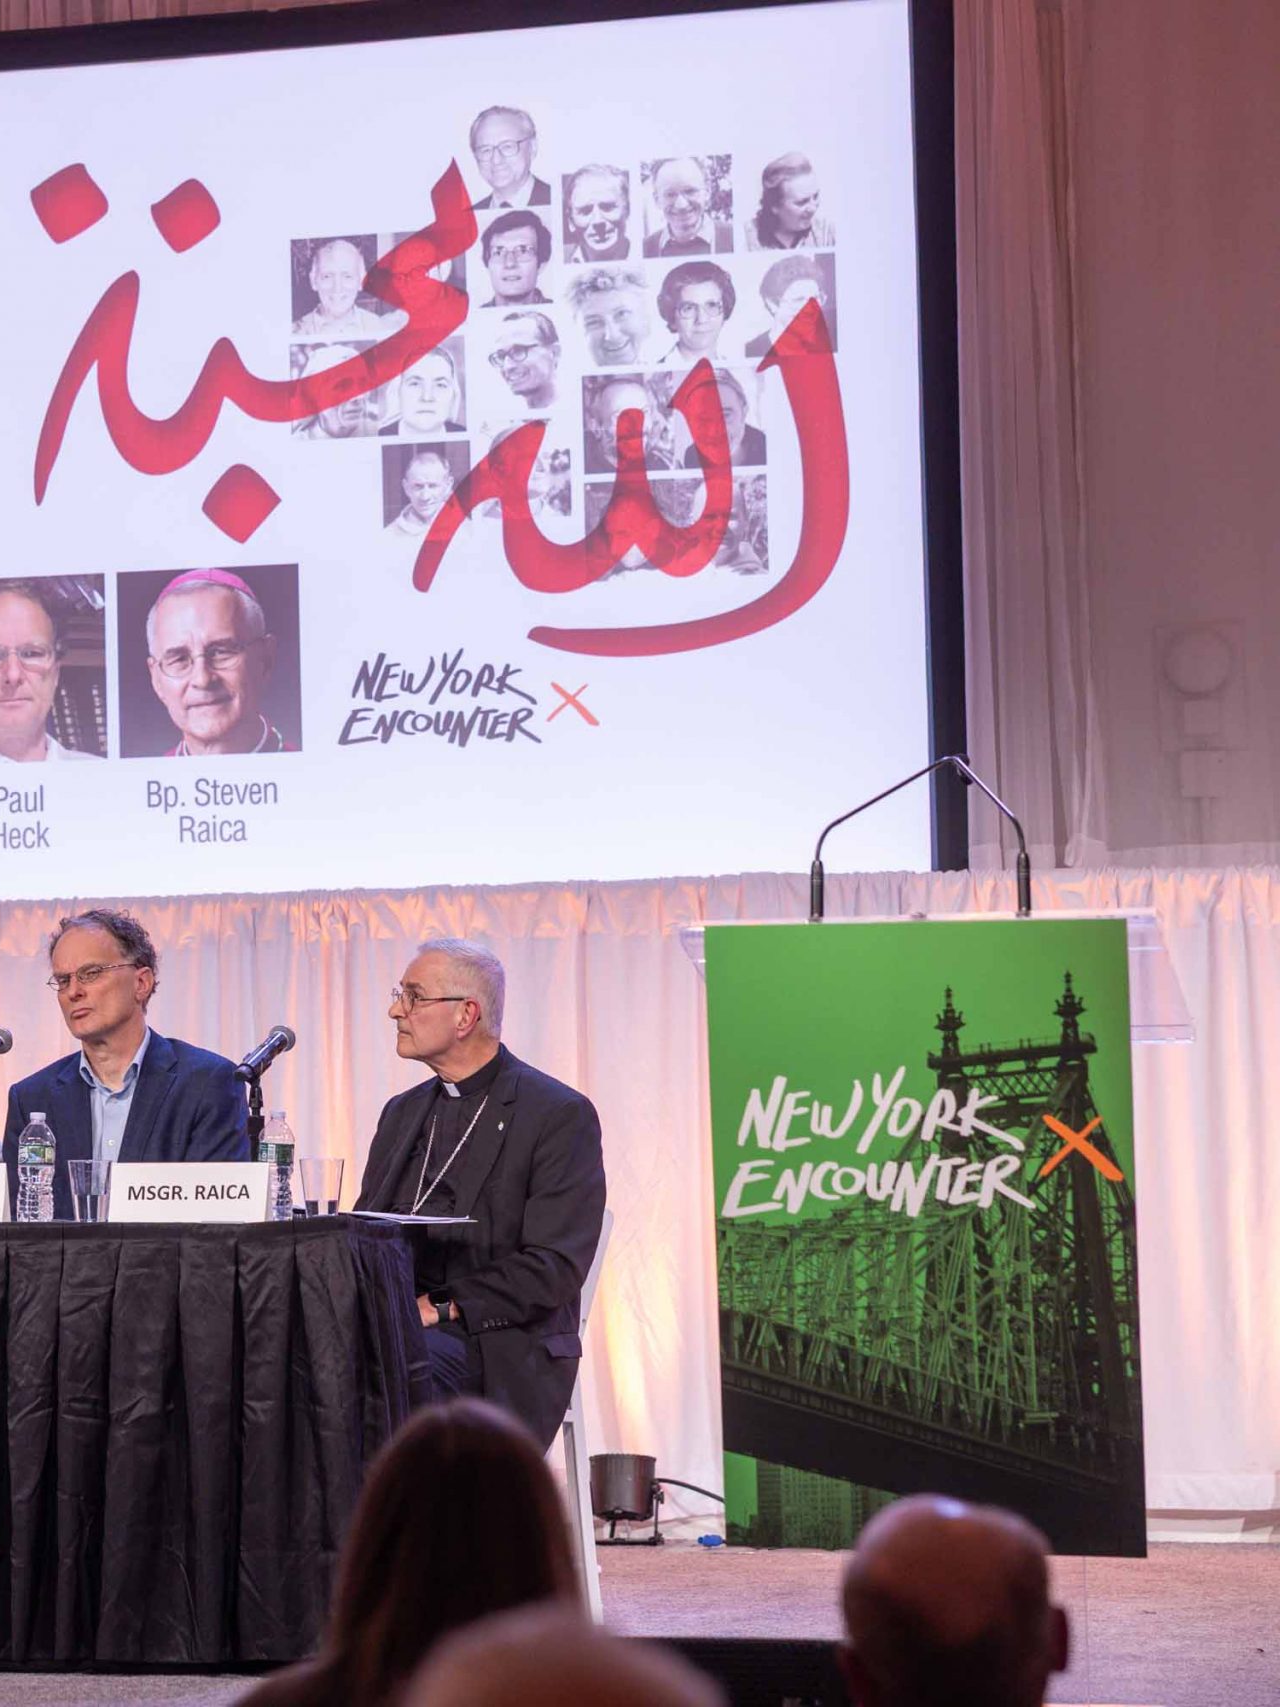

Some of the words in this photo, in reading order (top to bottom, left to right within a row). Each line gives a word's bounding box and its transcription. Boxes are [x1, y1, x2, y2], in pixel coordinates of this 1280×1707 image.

[351, 652, 435, 702] NEW
[428, 647, 538, 705] YORK
[337, 706, 542, 748] ENCOUNTER
[146, 780, 186, 810] Bp.
[194, 778, 278, 808] Steven
[179, 814, 247, 844] Raica
[737, 1075, 863, 1152] NEW
[856, 1065, 1025, 1154] YORK
[127, 1185, 188, 1201] MSGR.
[195, 1184, 250, 1201] RAICA
[721, 1154, 1036, 1218] ENCOUNTER
